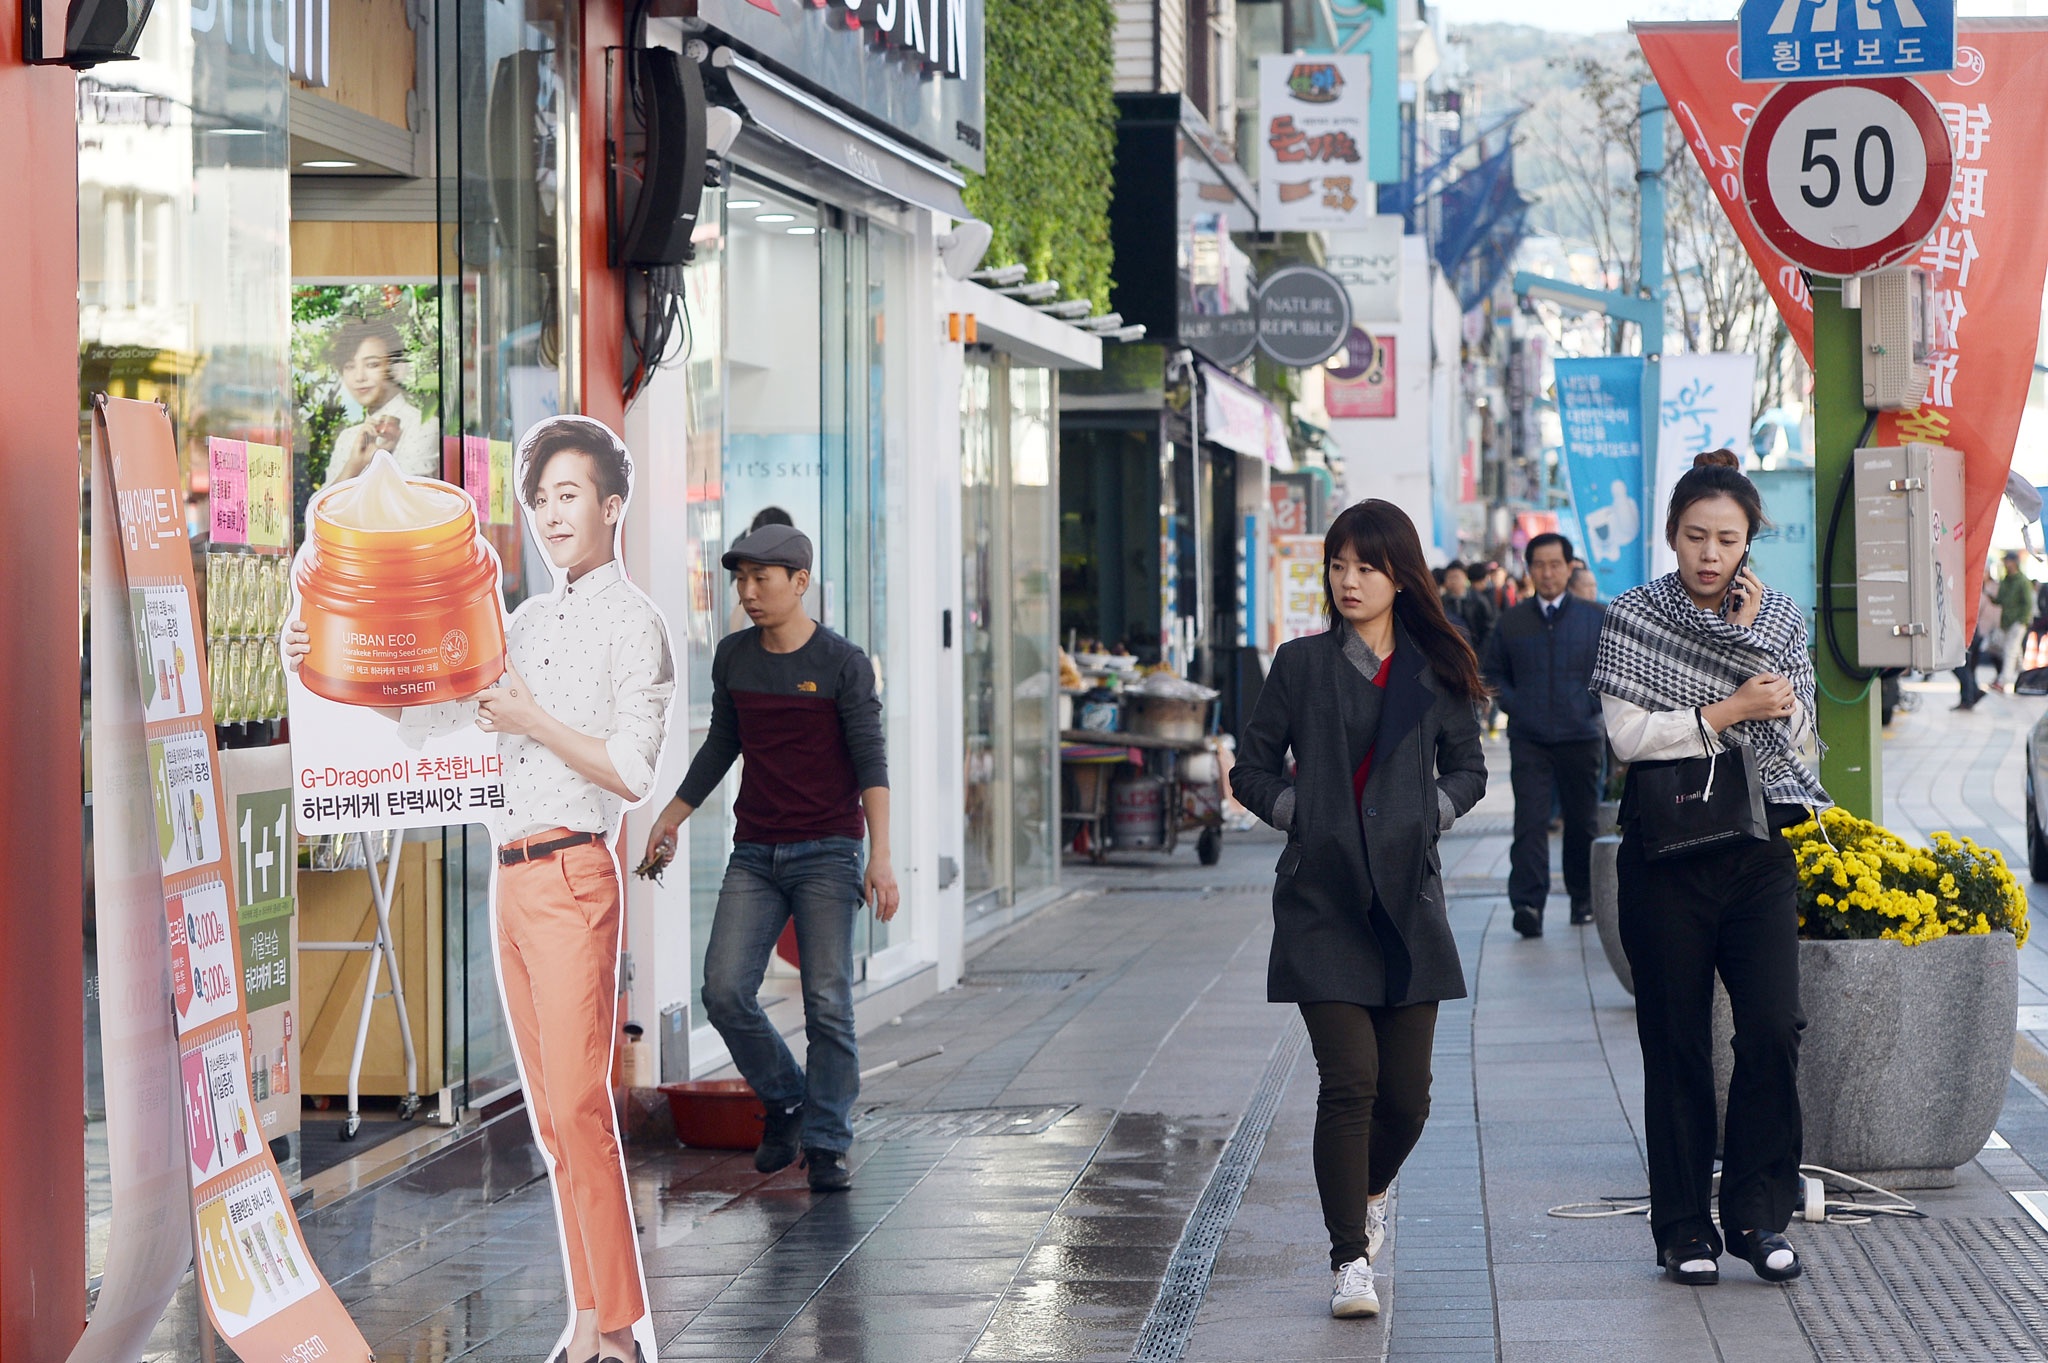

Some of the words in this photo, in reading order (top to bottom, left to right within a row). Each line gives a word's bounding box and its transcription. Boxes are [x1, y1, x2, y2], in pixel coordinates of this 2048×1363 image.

[1772, 37, 1925, 72] 횡단보도
[1800, 125, 1894, 208] 50
[1265, 297, 1334, 314] NATURE
[1260, 319, 1339, 336] REPUBLIC
[108, 349, 131, 359] Gold
[1566, 408, 1629, 424] 대한민국이
[167, 617, 179, 638] 증정
[342, 631, 385, 647] URBAN
[388, 633, 416, 647] ECO
[342, 647, 371, 658] Harakeke
[372, 648, 398, 659] Firming
[399, 647, 416, 657] Seed
[416, 646, 438, 655] Cream
[342, 663, 355, 675] 어반
[356, 665, 369, 675] 에코
[370, 665, 395, 676] 하라케케
[397, 665, 410, 676] 탄력
[412, 664, 425, 674] 씨앗
[426, 662, 439, 673] 크림
[194, 761, 210, 783] 증정
[301, 760, 409, 789] G-Dragon이
[415, 754, 504, 783] 추천합니다
[302, 792, 380, 822] 하라케케
[387, 787, 463, 816] 탄력씨앗
[468, 783, 505, 809] 크림
[240, 803, 287, 905] 1+1
[250, 929, 279, 961] 겨울보습
[245, 961, 272, 995] 하라케케
[273, 957, 286, 986] 크림
[185, 1072, 211, 1149] 1+1
[229, 1198, 254, 1225] 폼클렌징
[251, 1193, 266, 1213] 하나
[203, 1216, 246, 1294] 1+1
